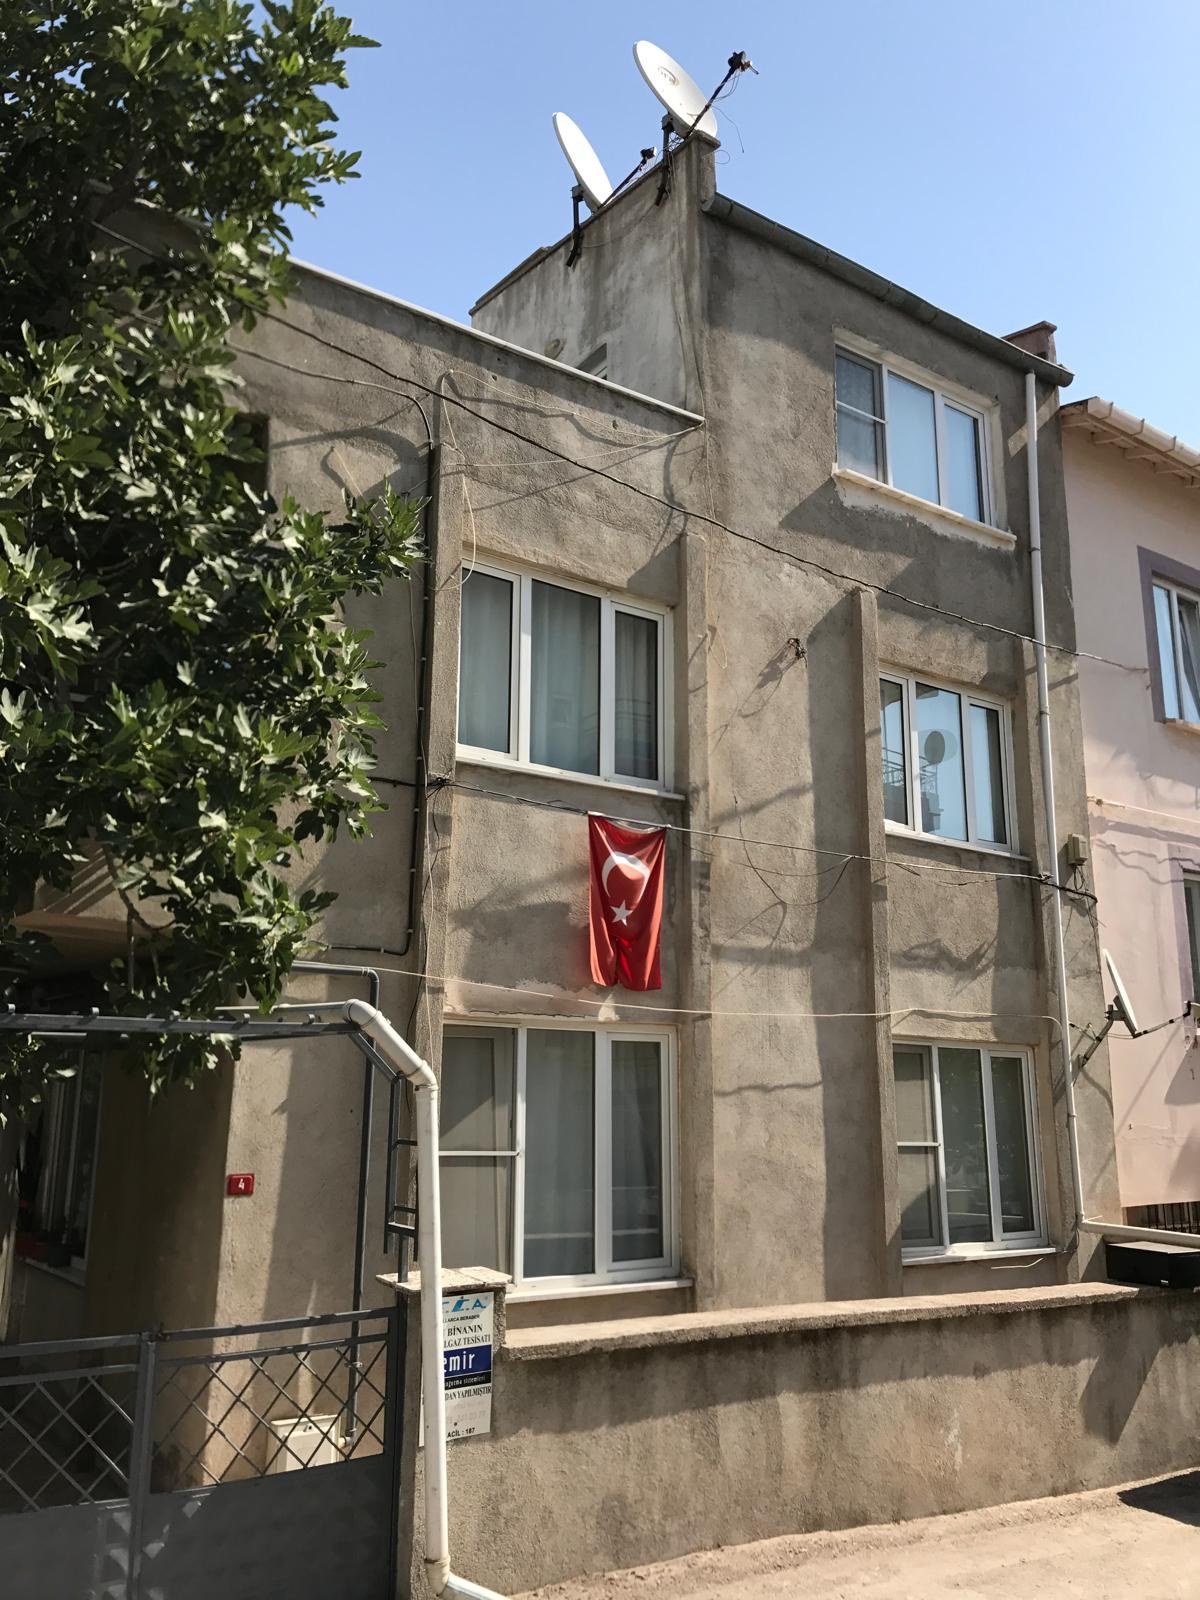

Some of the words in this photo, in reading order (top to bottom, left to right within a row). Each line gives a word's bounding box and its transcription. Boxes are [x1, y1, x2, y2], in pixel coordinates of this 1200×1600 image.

[238, 1178, 245, 1190] 4
[447, 1324, 483, 1336] BİNANIN
[443, 1337, 461, 1348] LGAZ
[463, 1334, 491, 1346] TESİSATI
[443, 1351, 475, 1372] emir
[445, 1391, 456, 1400] DAN
[457, 1386, 492, 1398] YAPILMIŞTIR
[447, 1429, 460, 1437] ACİL
